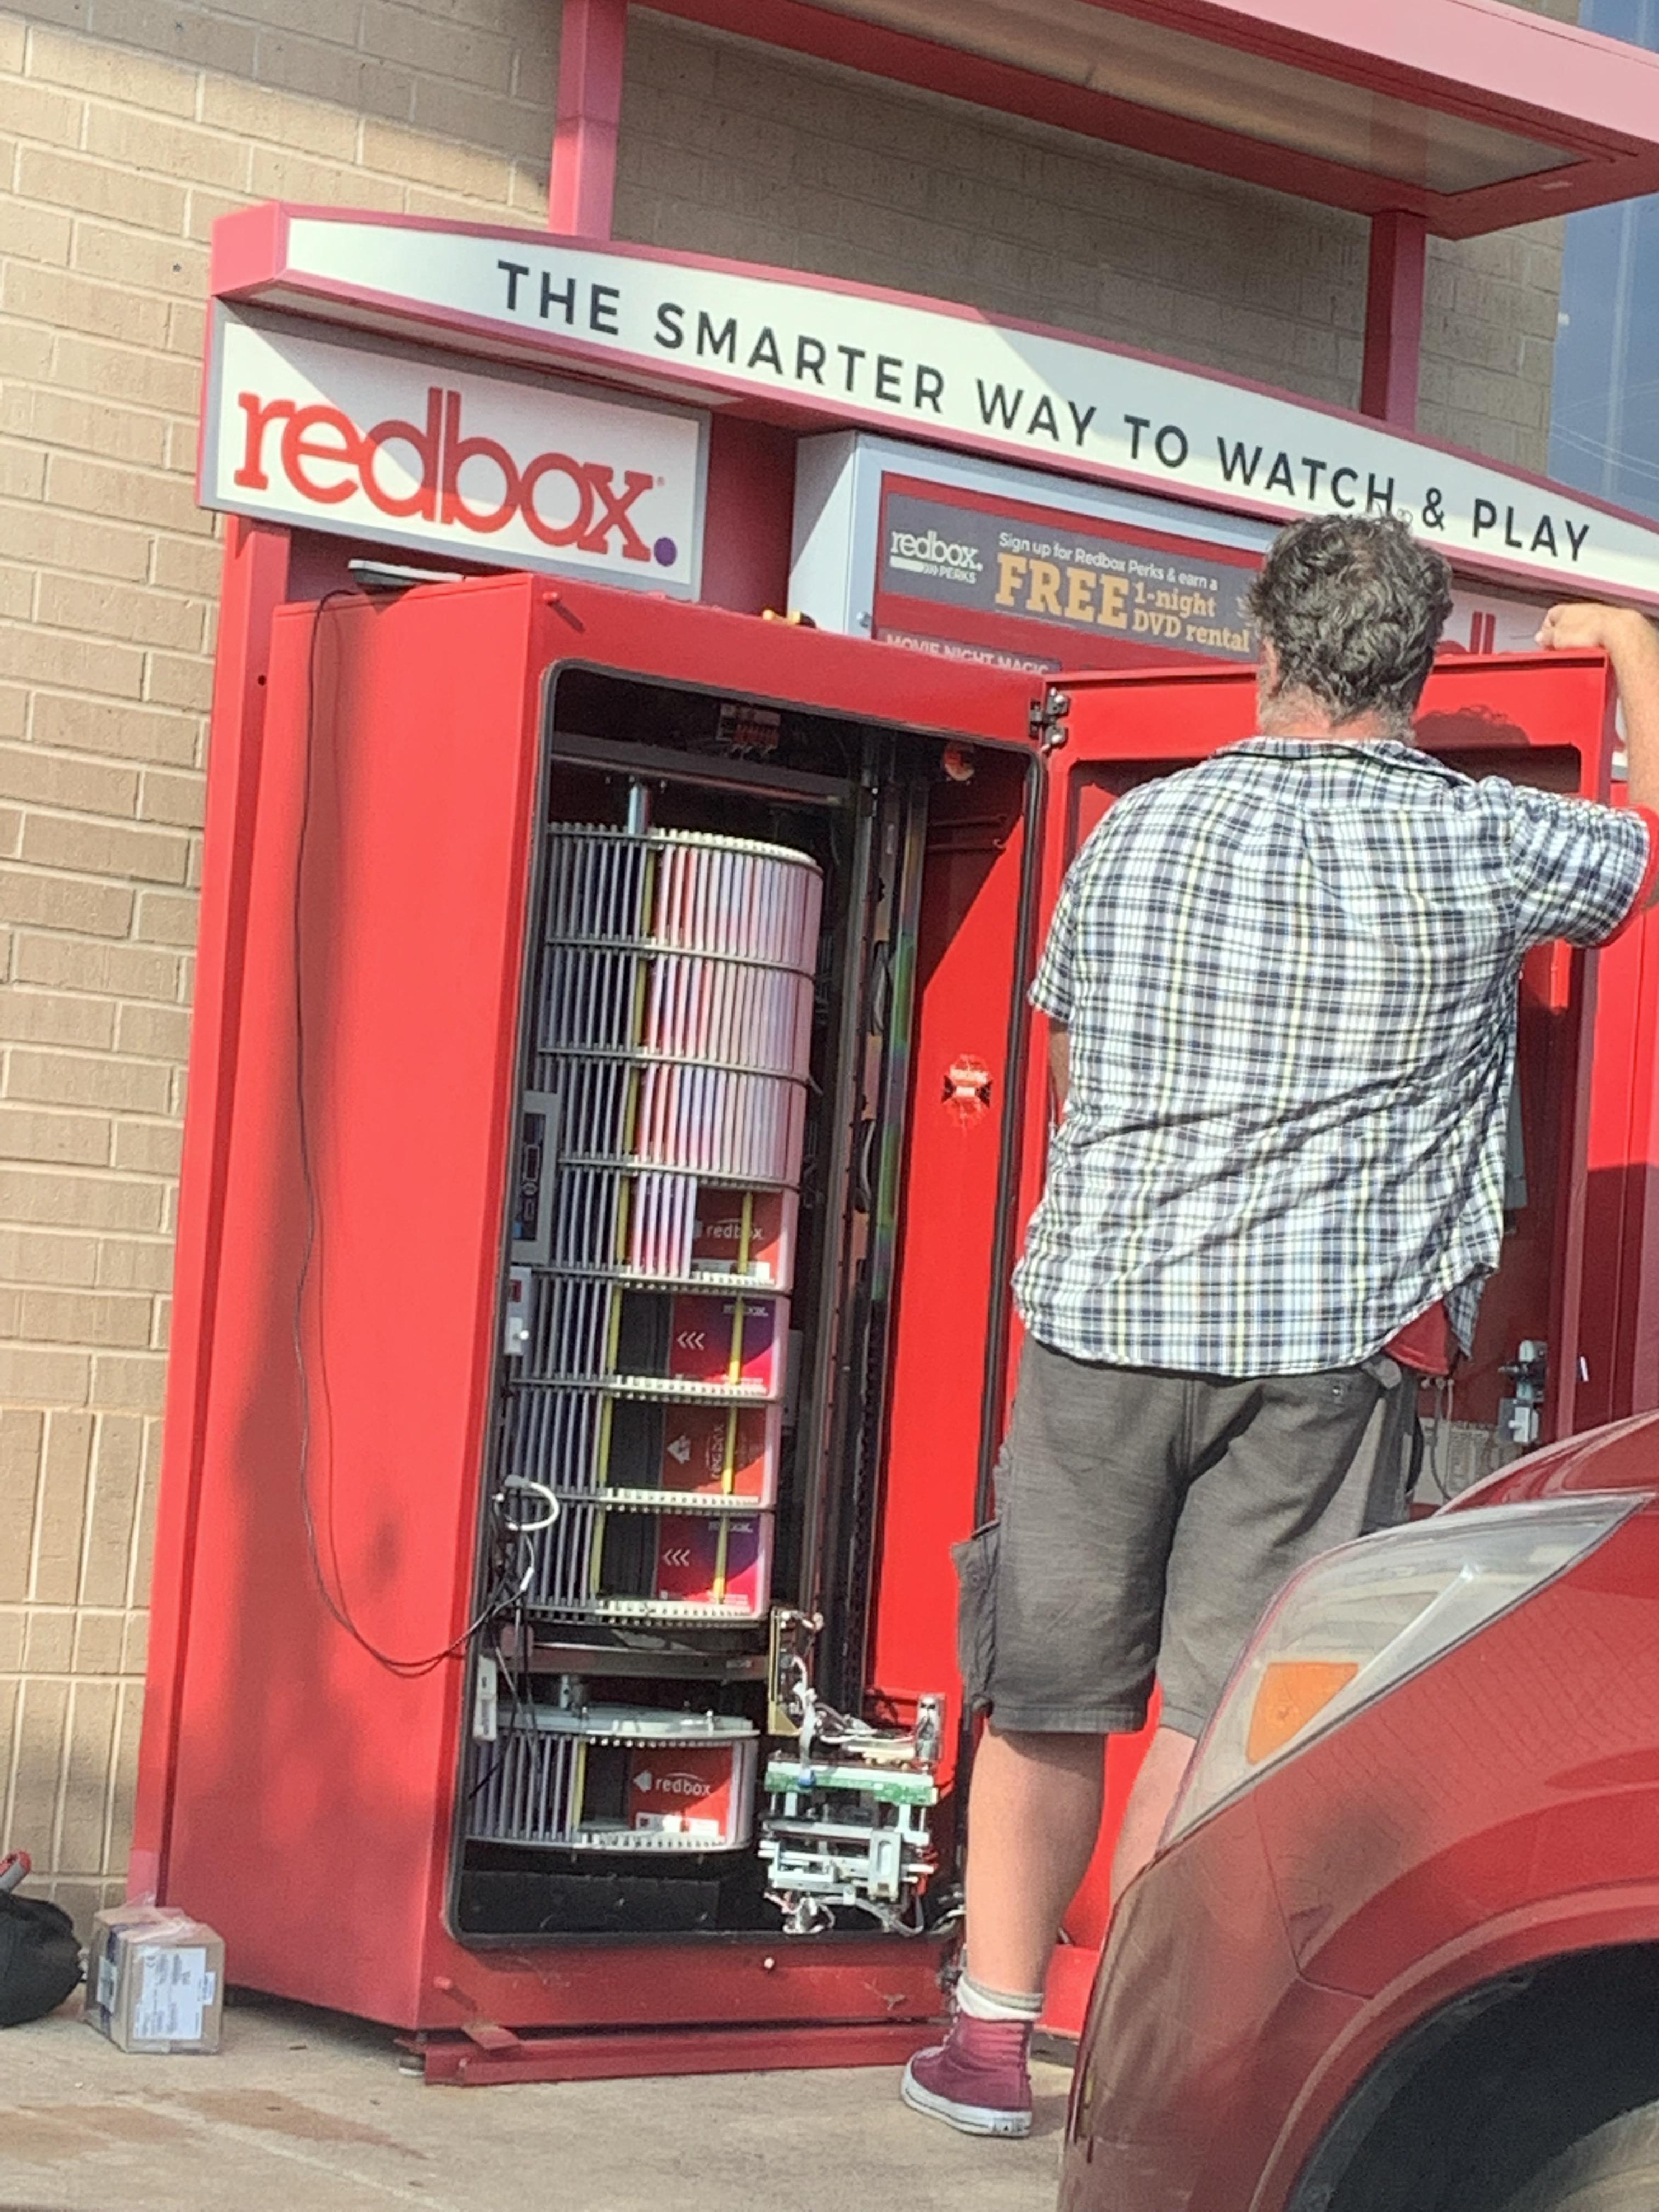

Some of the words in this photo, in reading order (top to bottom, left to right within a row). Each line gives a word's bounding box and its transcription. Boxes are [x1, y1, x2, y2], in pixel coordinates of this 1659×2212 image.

[497, 259, 620, 336] THE
[654, 302, 945, 414] SMARTER
[976, 378, 1097, 447] WAY
[1124, 414, 1189, 468] TO
[1217, 436, 1395, 514] WATCH
[1422, 487, 1444, 531] &
[1472, 498, 1590, 561] PLAY
[939, 565, 977, 584] PERKS
[998, 532, 1030, 553] Sign
[1033, 542, 1051, 558] up
[1053, 541, 1073, 561] for
[1074, 548, 1126, 572] Redbox
[1128, 559, 1164, 581] Perks
[1166, 567, 1176, 583] &
[1178, 572, 1207, 589] earn
[1209, 578, 1218, 591] a
[995, 551, 1130, 630] FREE
[1134, 580, 1216, 619] 1-night
[1132, 607, 1182, 639] DVD
[1186, 623, 1250, 653] rental
[656, 1778, 712, 1797] redbox
